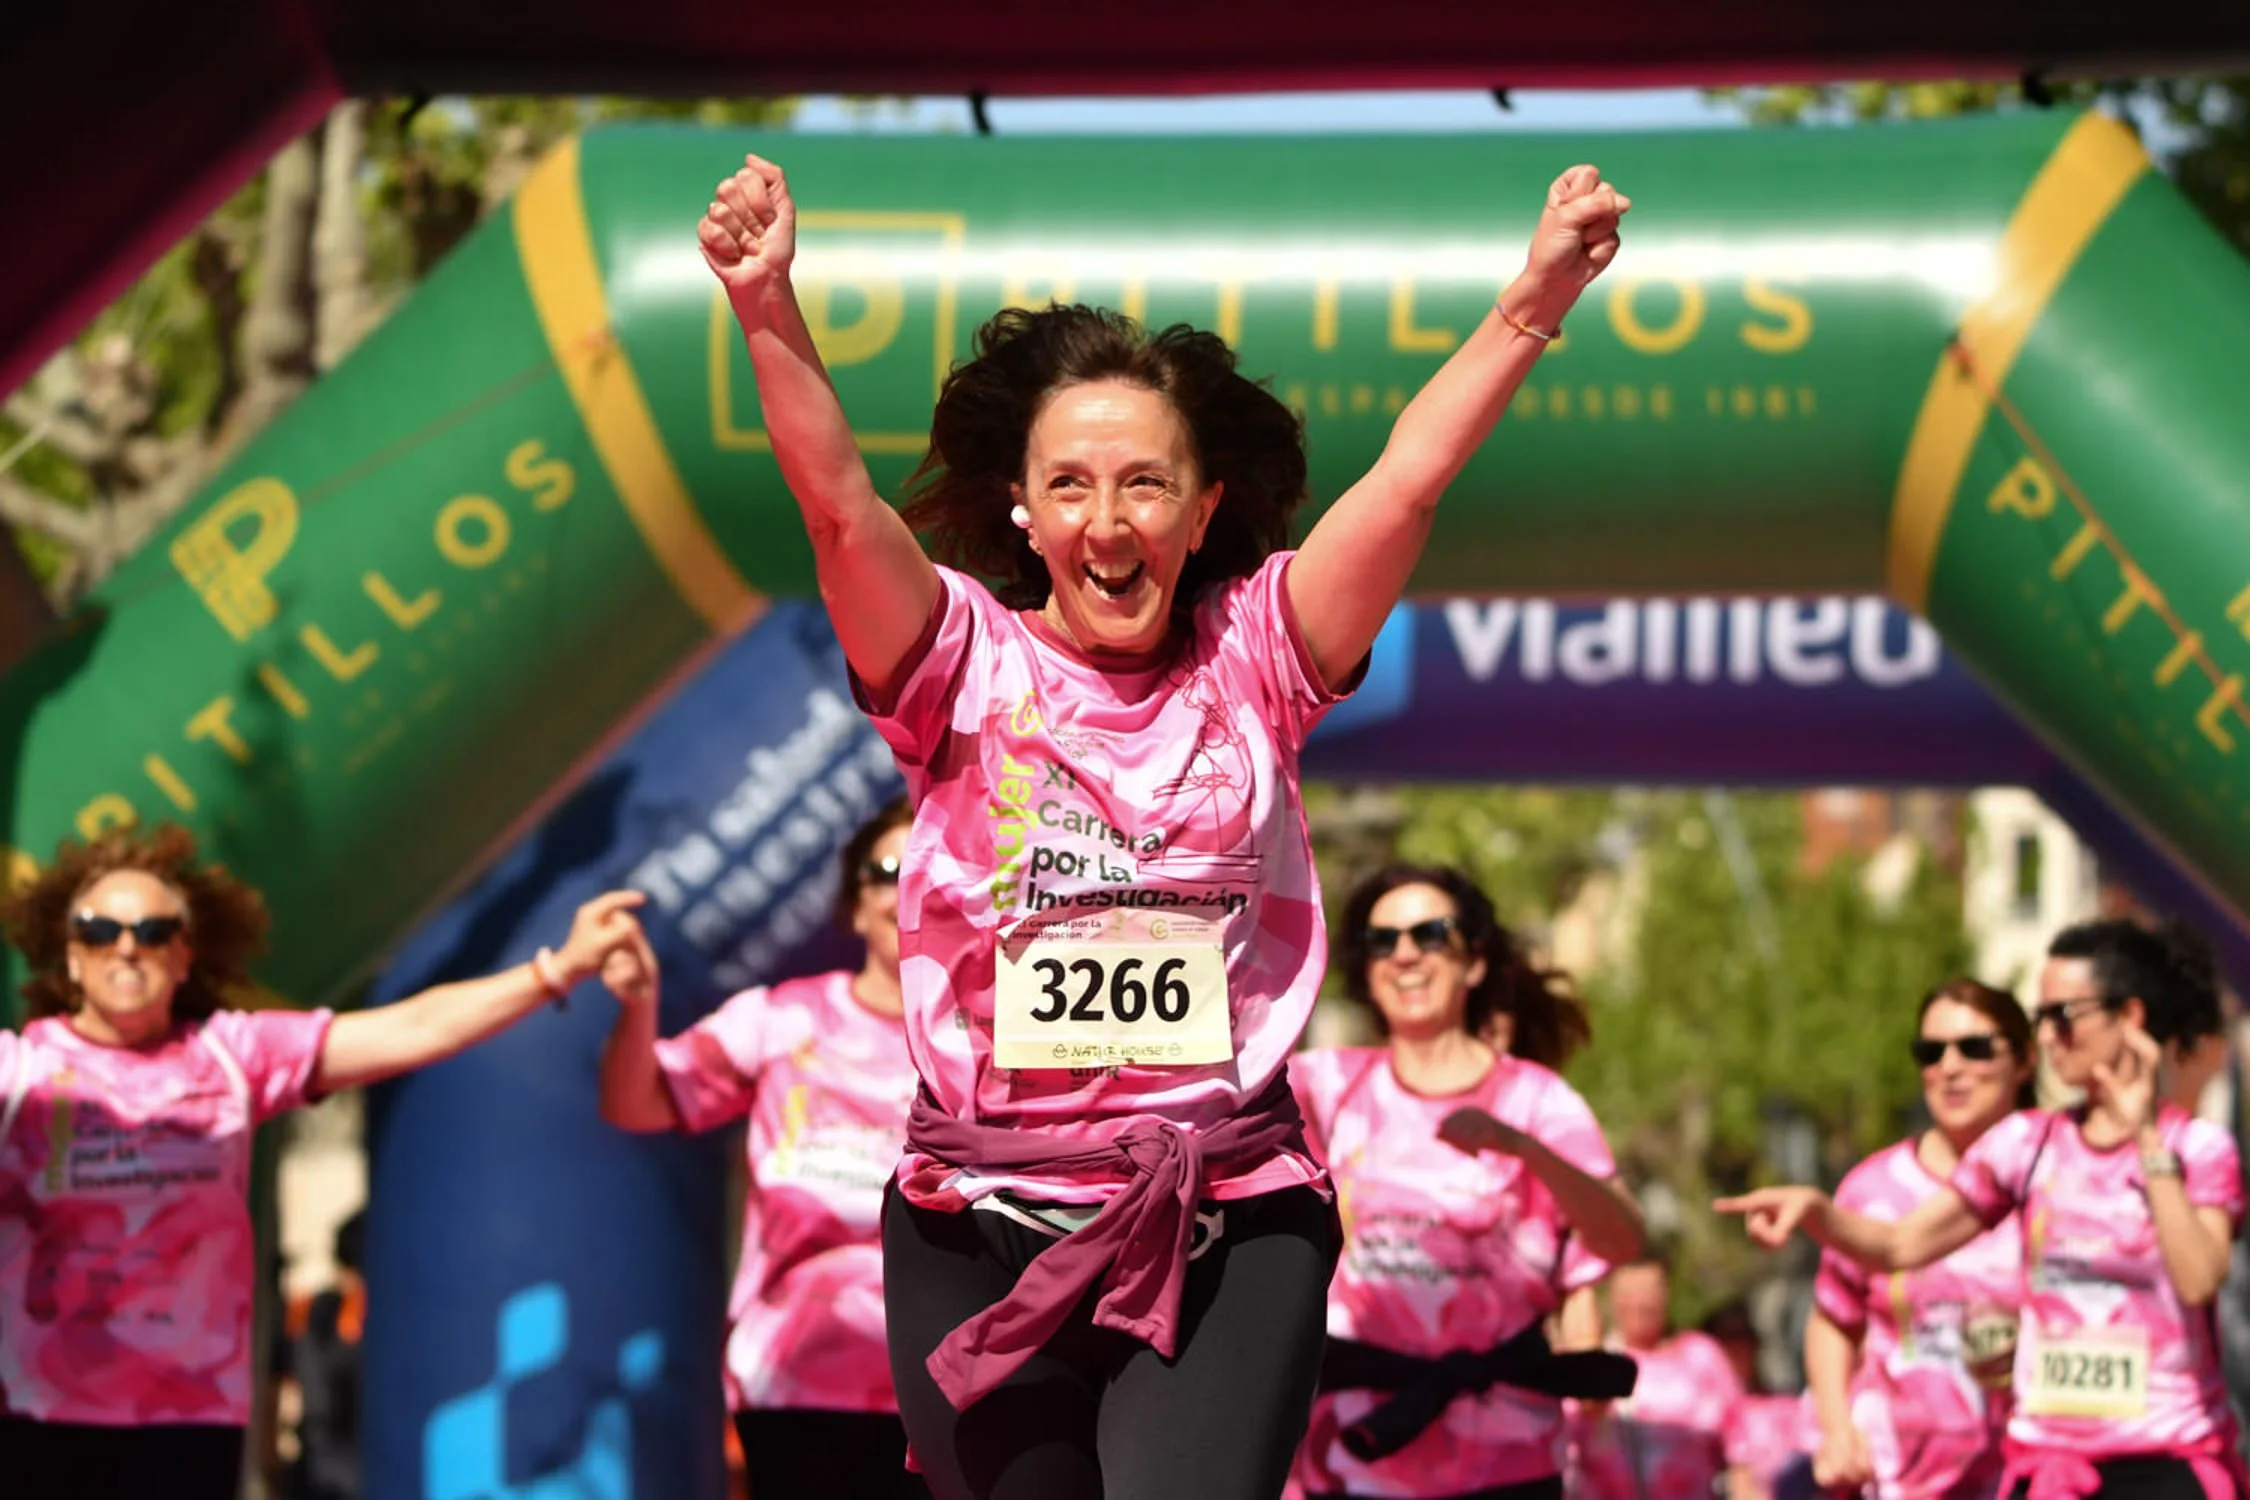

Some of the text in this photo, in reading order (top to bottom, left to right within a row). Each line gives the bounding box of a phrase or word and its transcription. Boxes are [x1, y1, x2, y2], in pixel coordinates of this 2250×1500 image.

[1037, 799, 1164, 855] Carrera
[1029, 844, 1091, 879] por
[1071, 920, 1089, 930] por
[1030, 957, 1191, 1023] 3266
[2042, 1352, 2133, 1393] 10281
